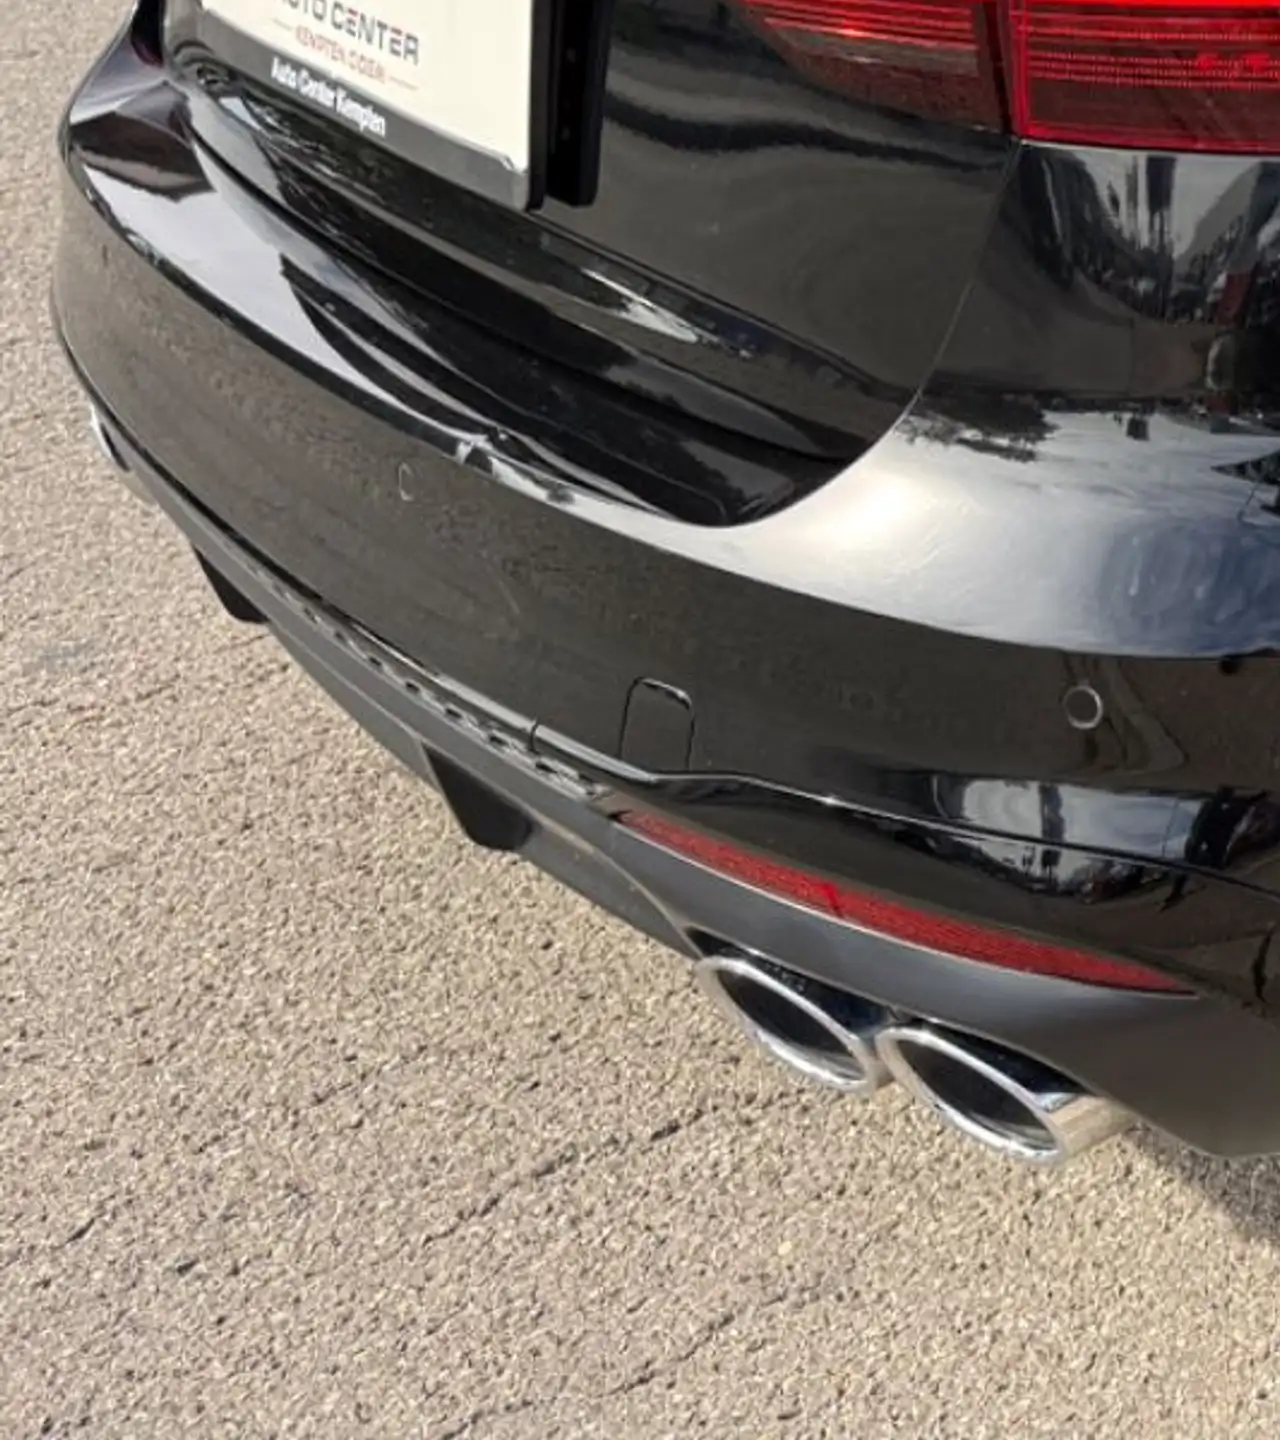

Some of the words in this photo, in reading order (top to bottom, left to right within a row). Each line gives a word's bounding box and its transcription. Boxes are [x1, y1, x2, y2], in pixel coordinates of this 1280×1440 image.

[330, 3, 420, 65] CENTER
[271, 57, 298, 87] Auto
[299, 71, 335, 107] Center
[335, 88, 386, 138] Kempten
